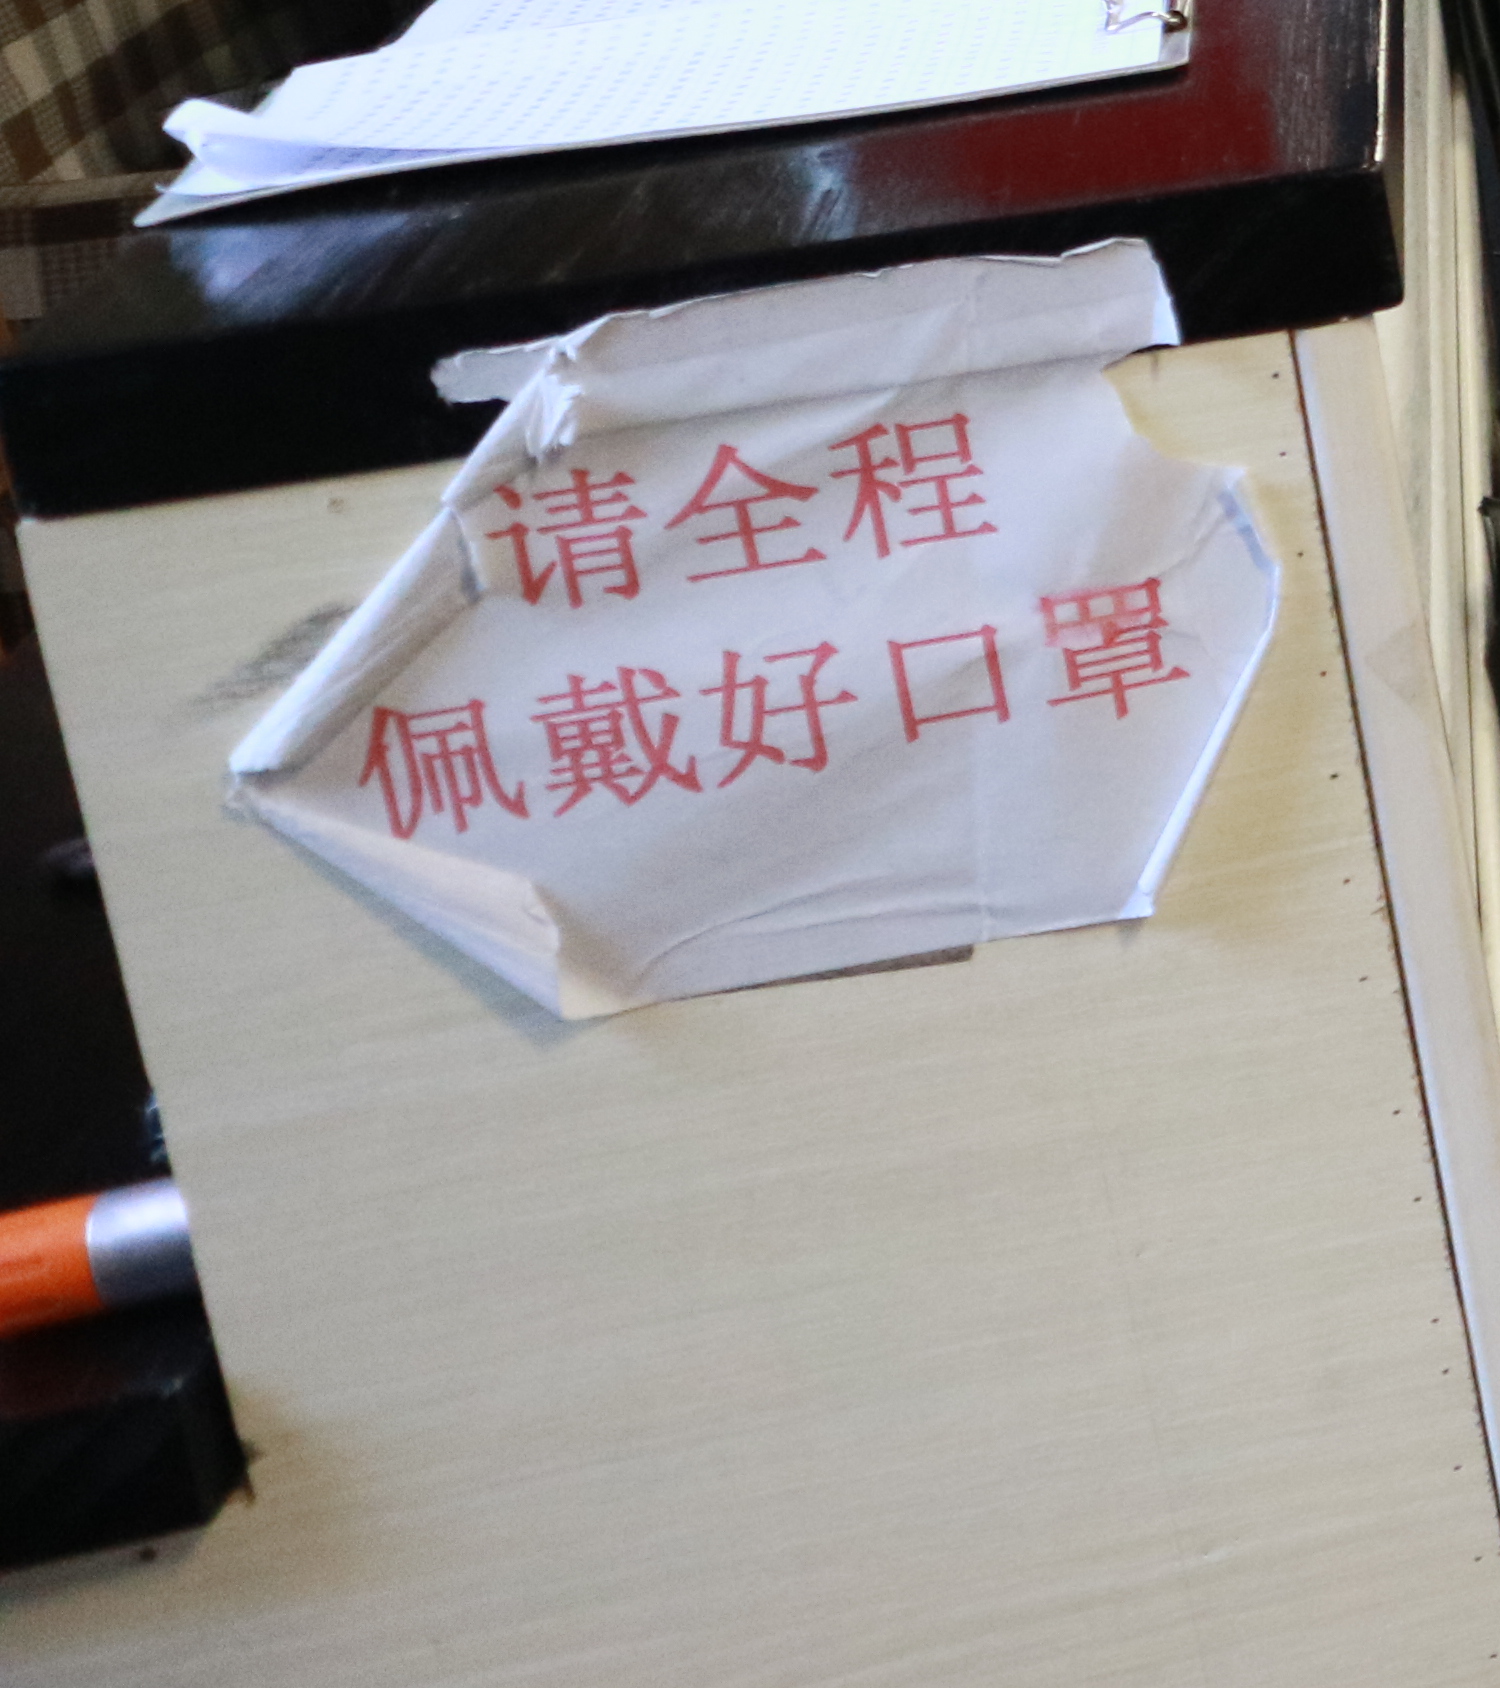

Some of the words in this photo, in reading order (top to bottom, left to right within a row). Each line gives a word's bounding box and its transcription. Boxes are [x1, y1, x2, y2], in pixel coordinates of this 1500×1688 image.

[486, 410, 1002, 610] 请全程
[358, 577, 1192, 841] 佩戴好口罩
